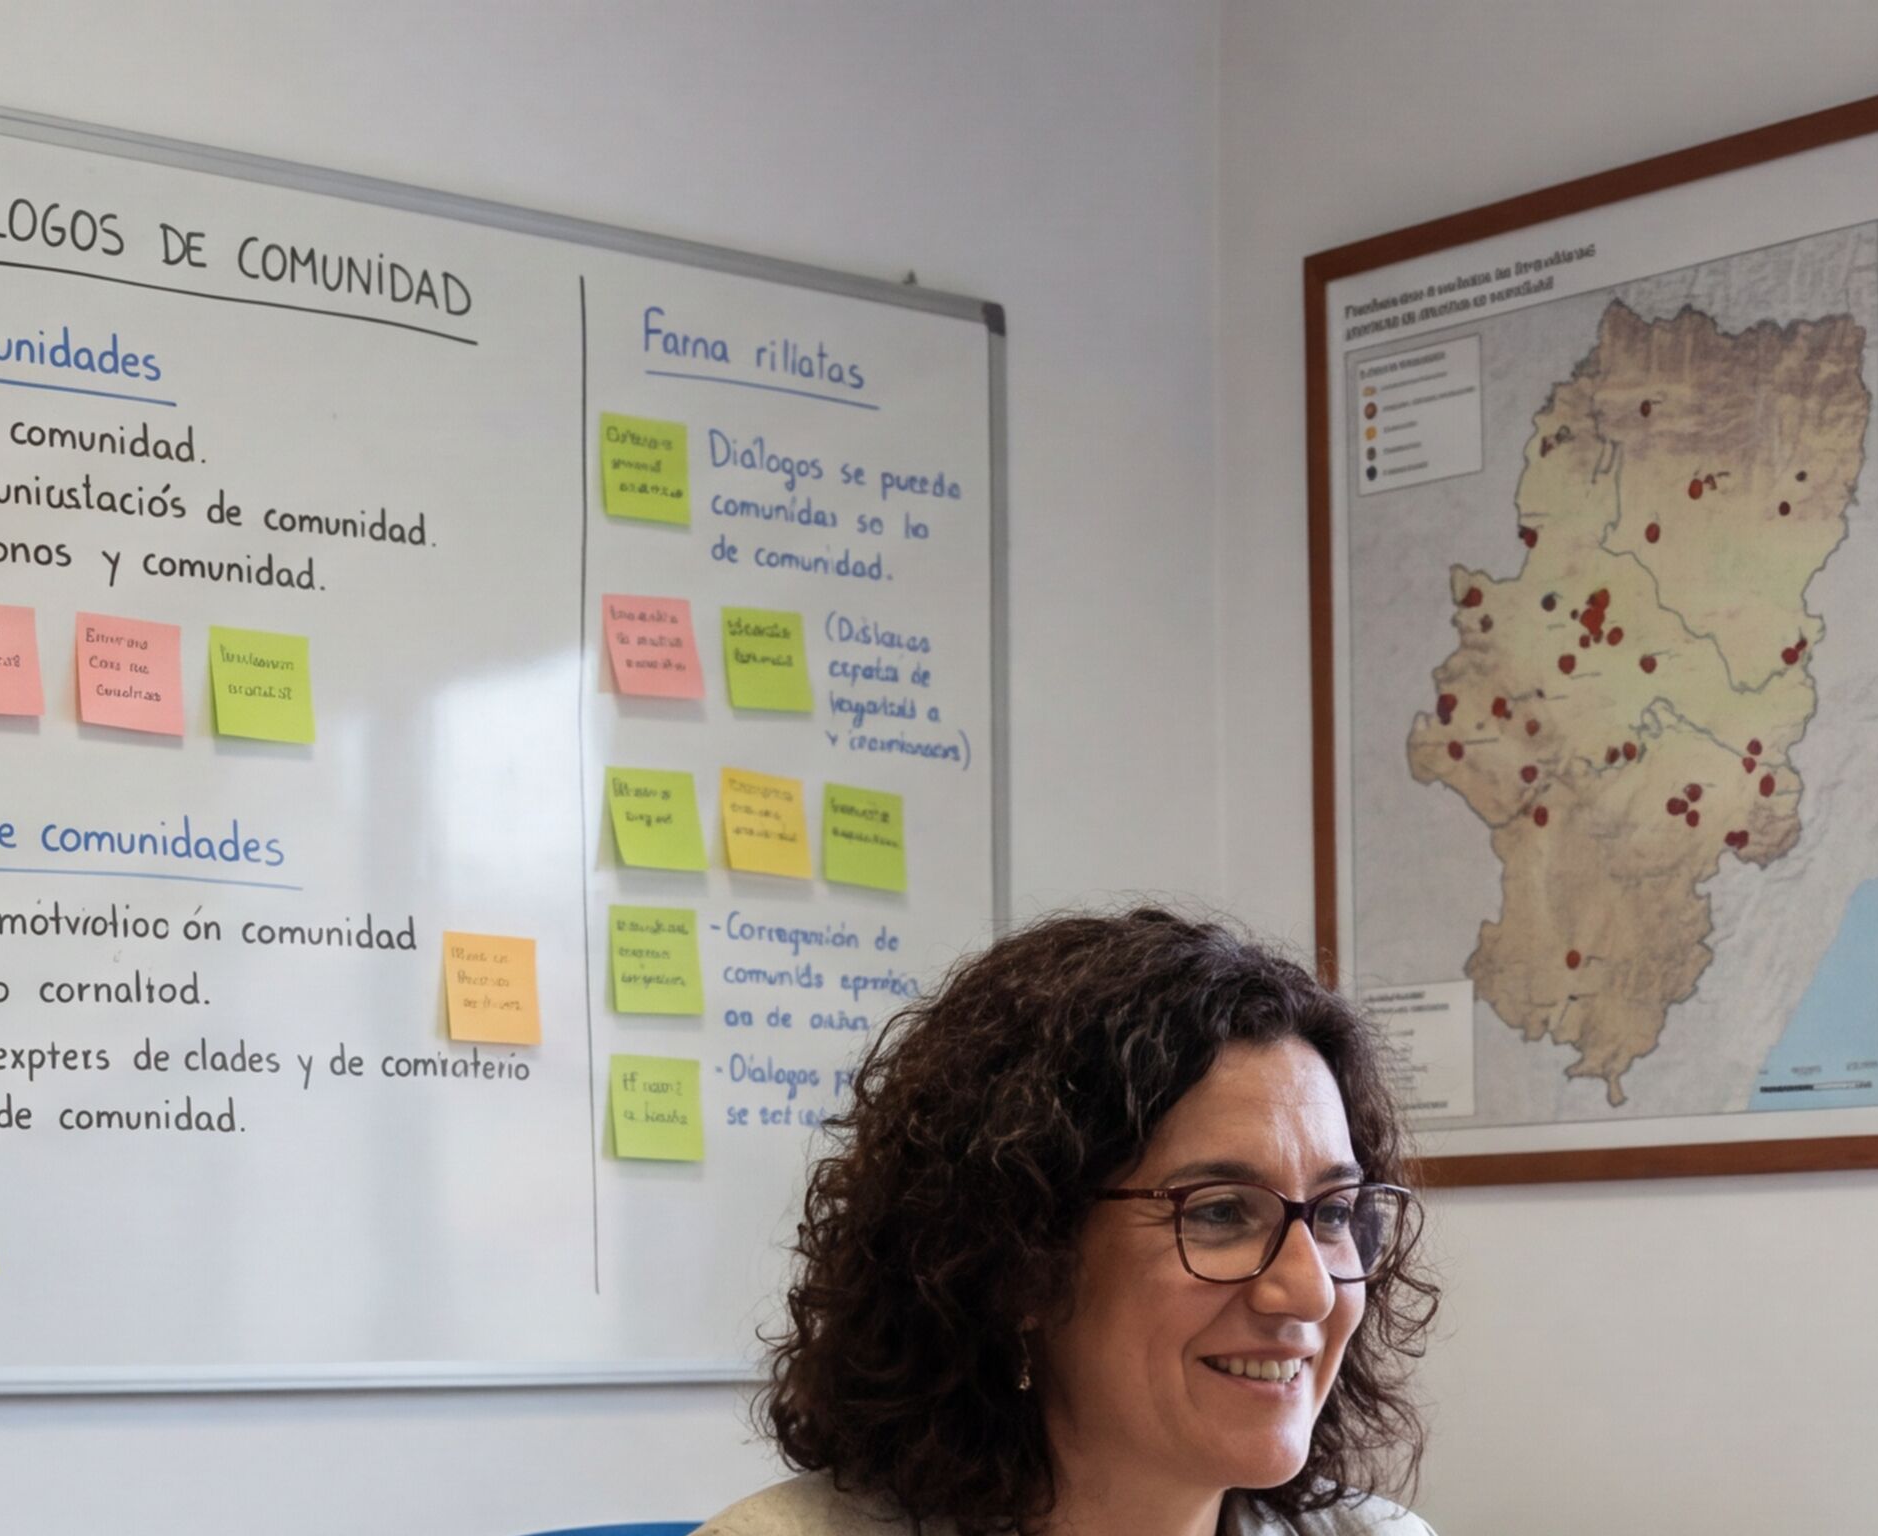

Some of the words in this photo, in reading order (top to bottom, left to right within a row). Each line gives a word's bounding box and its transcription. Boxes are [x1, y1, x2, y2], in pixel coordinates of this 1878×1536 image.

[161, 219, 208, 270] DE
[237, 235, 473, 318] COMUNIDAD
[9, 419, 208, 466] comunidad.
[840, 463, 867, 487] se
[208, 489, 243, 528] de
[263, 505, 438, 549] comunidad.
[101, 548, 123, 588] y
[142, 550, 327, 592] comunidad.
[711, 533, 739, 564] de
[39, 809, 288, 869] comunidades
[241, 912, 418, 952] comunidad
[766, 1005, 793, 1029] de
[133, 1037, 170, 1073] de
[184, 1037, 281, 1074] clades
[296, 1052, 314, 1091] y
[329, 1042, 364, 1078] de
[59, 1095, 246, 1135] comunidad.
